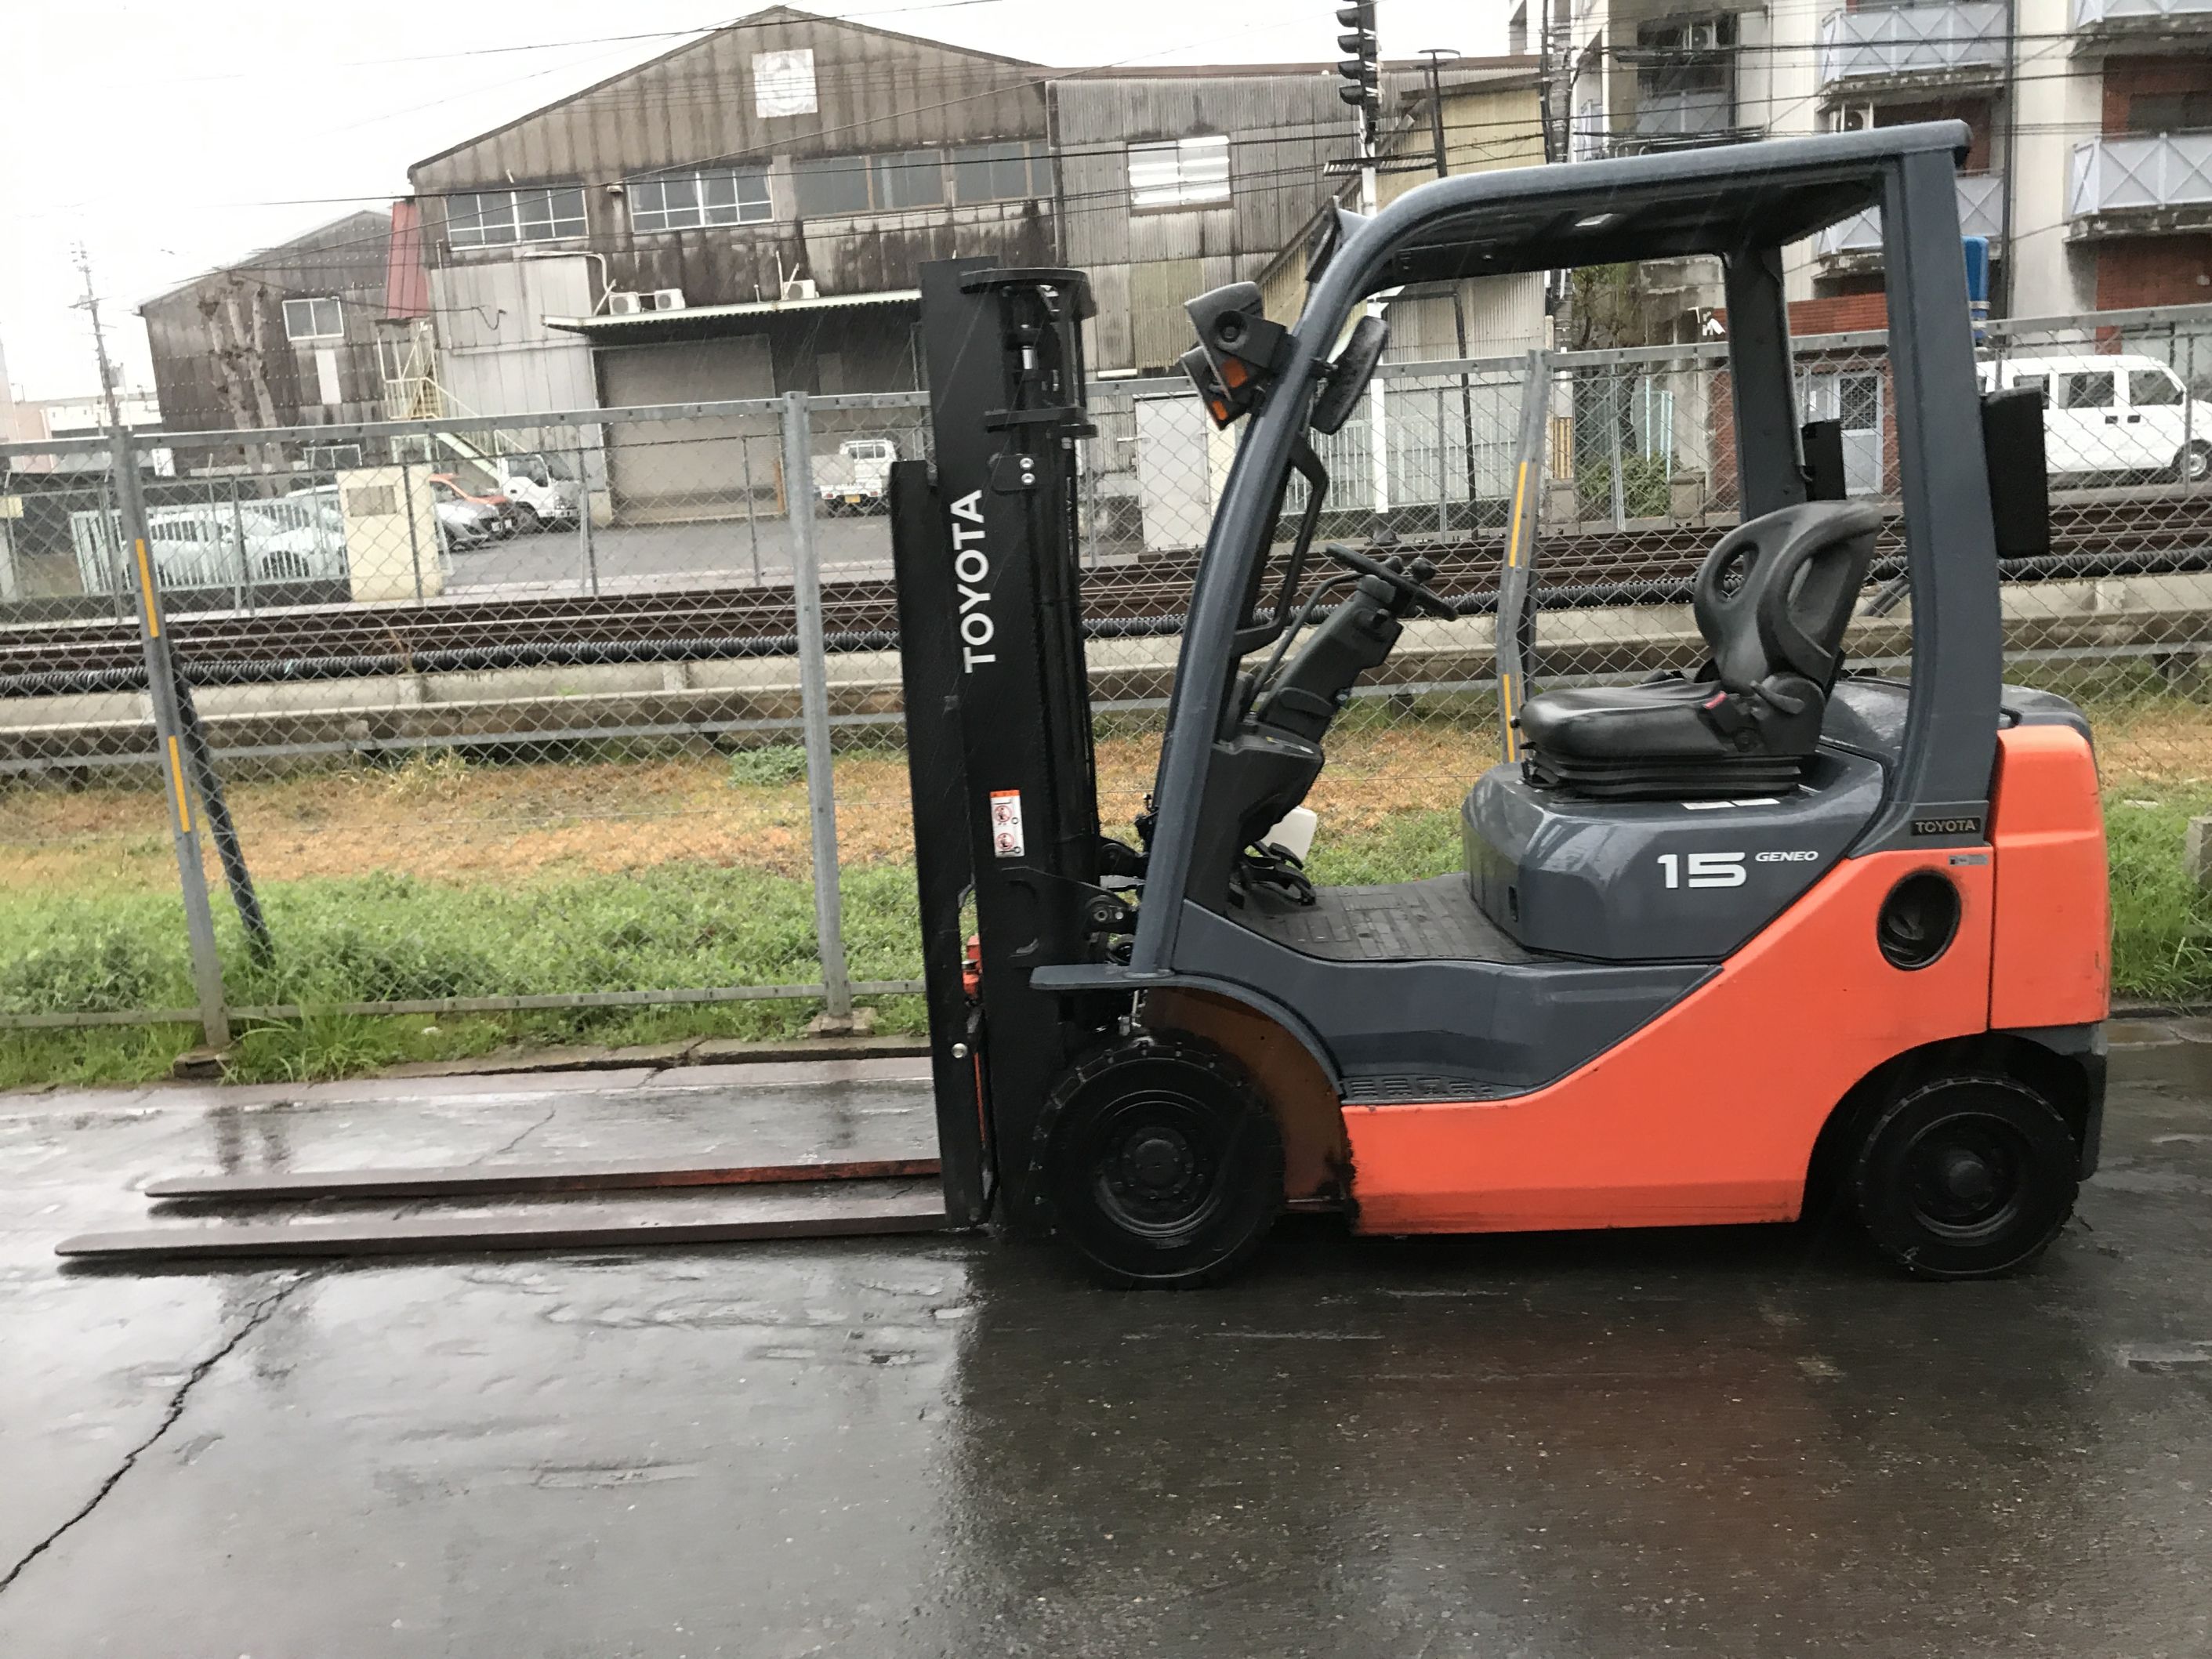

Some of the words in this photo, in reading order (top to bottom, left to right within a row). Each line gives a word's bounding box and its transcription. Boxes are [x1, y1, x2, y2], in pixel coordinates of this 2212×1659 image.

[950, 490, 996, 673] TOYOTA
[1915, 820, 1976, 833] TOYOTA
[1657, 852, 1746, 888] 15
[1755, 851, 1819, 862] GENEO
